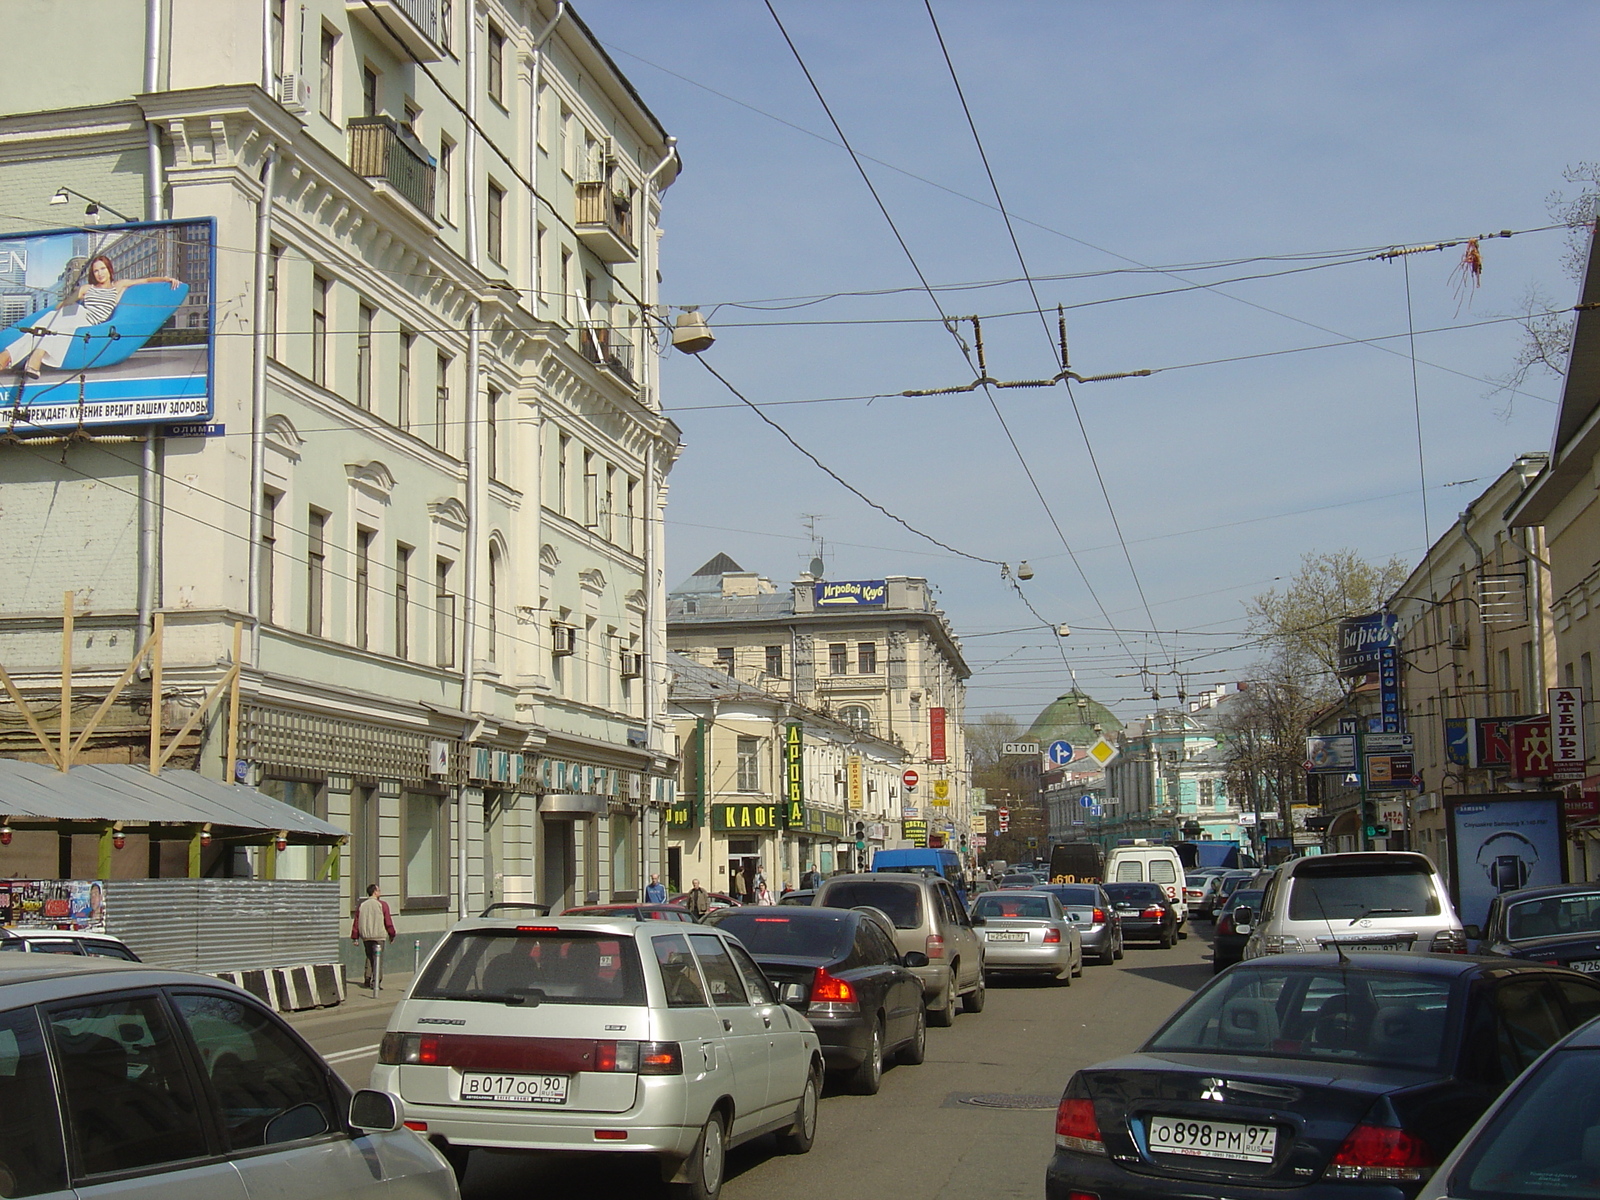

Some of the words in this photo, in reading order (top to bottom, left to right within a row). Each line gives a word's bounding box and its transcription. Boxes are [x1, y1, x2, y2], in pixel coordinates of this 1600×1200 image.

[105, 403, 134, 418] ВРЕДИТ
[173, 425, 215, 434] ОЛИМП
[1556, 690, 1577, 760] АТЕЛЬЕ
[1005, 744, 1035, 753] СТОП
[470, 747, 524, 785] МИР
[537, 758, 620, 797] СПОРТА
[788, 726, 802, 820] ДРОВА
[726, 806, 776, 828] КАФЕ
[904, 820, 927, 829] ЦВЕТЫ
[543, 1077, 561, 1091] 90
[1248, 1127, 1270, 1146] 97
[1246, 1145, 1261, 1153] RUS
